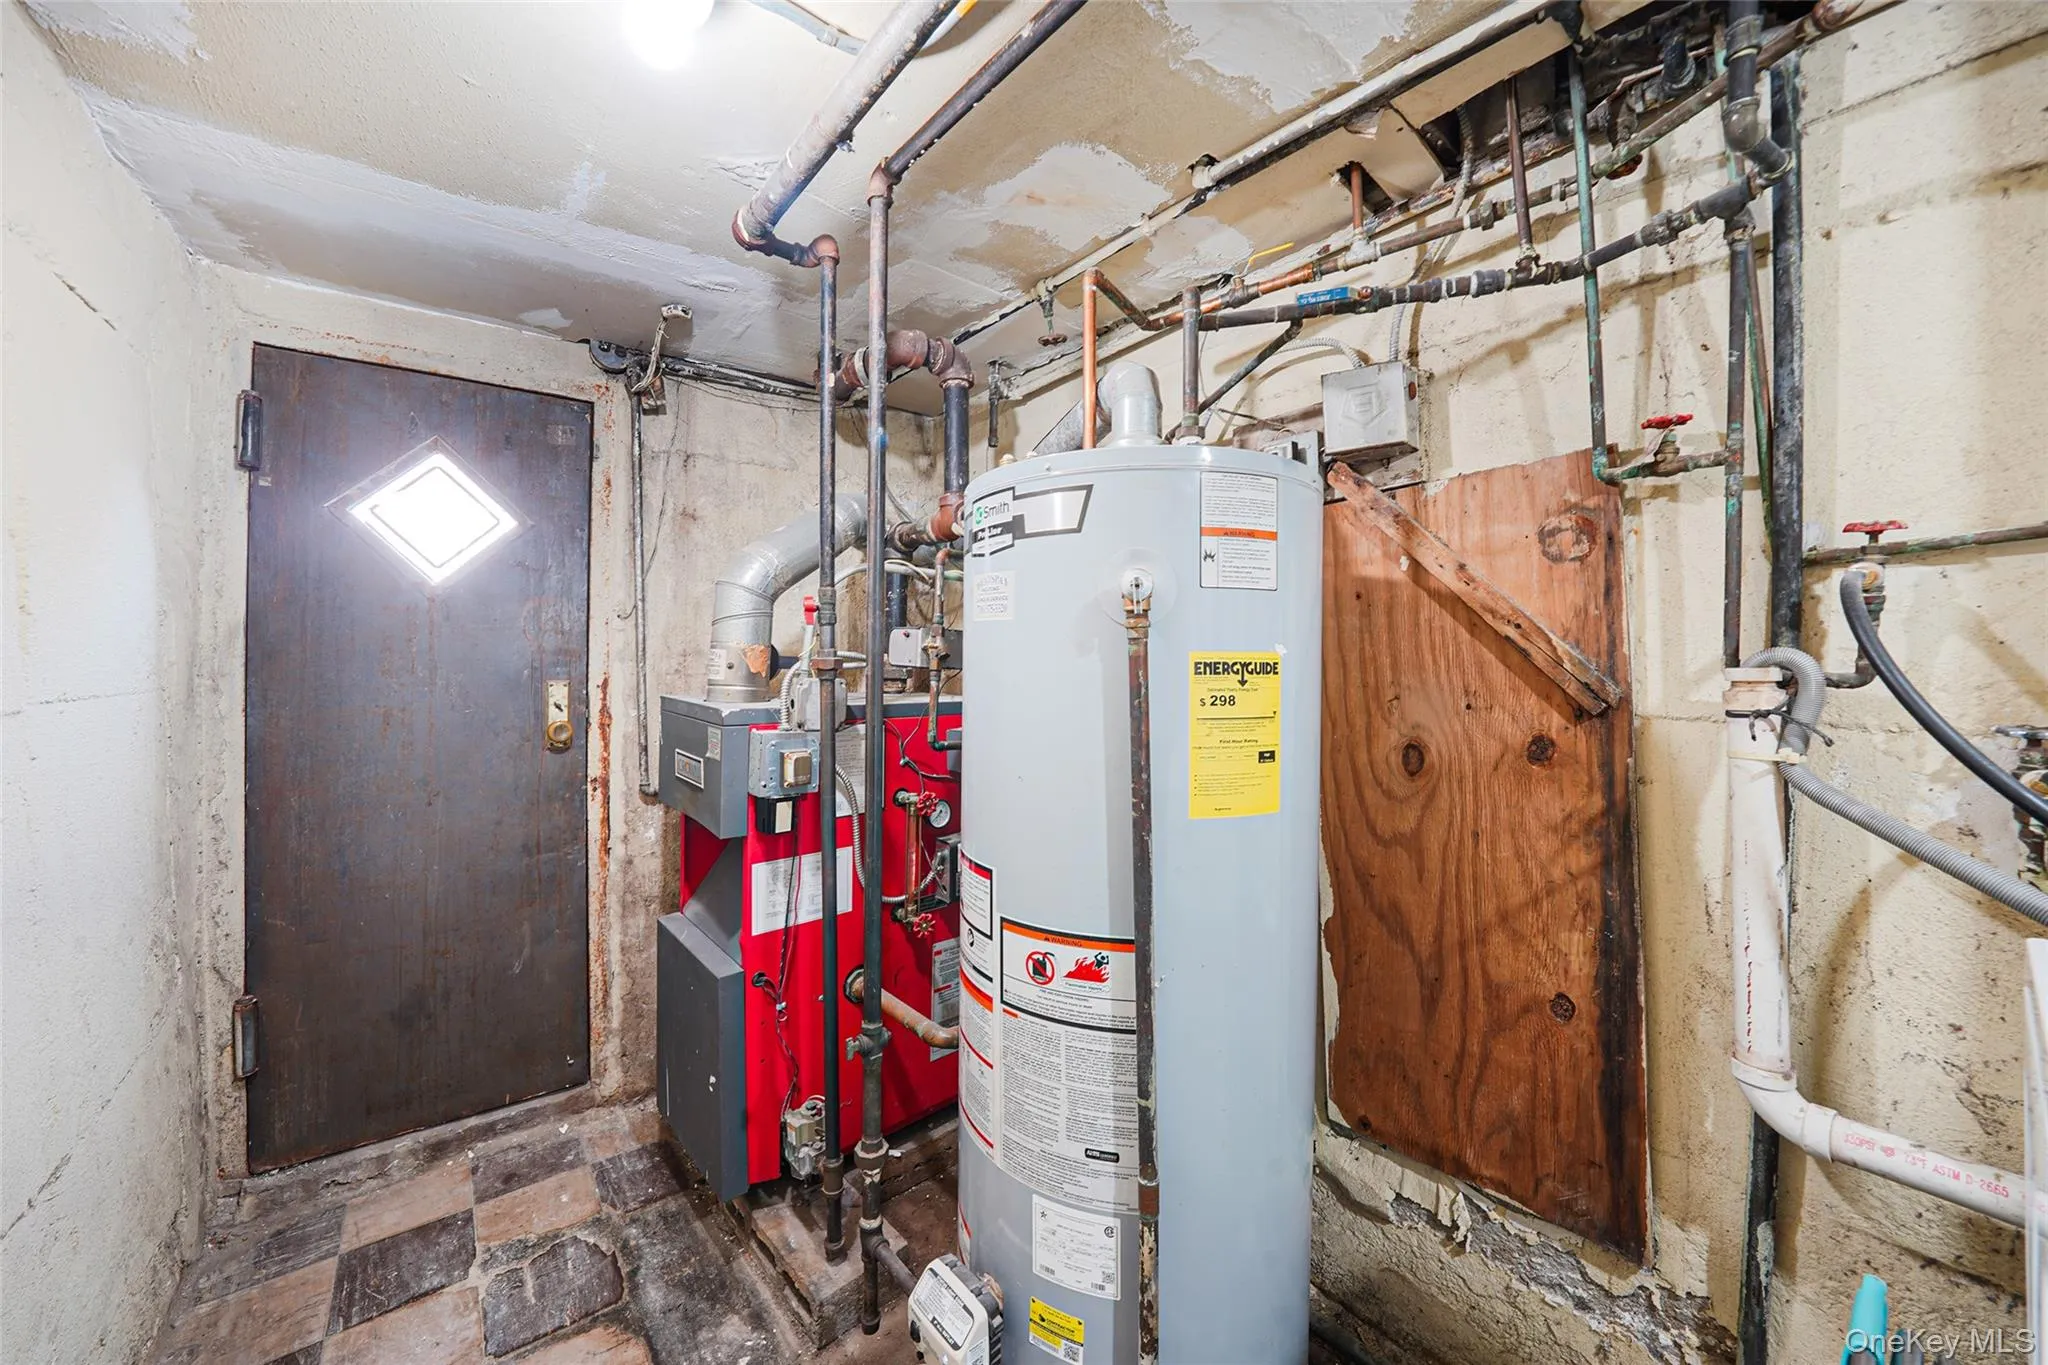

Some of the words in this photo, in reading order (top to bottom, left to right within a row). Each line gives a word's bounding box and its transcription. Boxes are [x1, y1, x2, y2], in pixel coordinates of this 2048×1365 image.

[983, 501, 1010, 519] Smith
[1194, 661, 1279, 681] ENERGYGUIDE
[1199, 698, 1206, 707] $
[1210, 694, 1236, 707] 298
[1051, 937, 1082, 948] WARNING
[1932, 1163, 1961, 1182] ASTM
